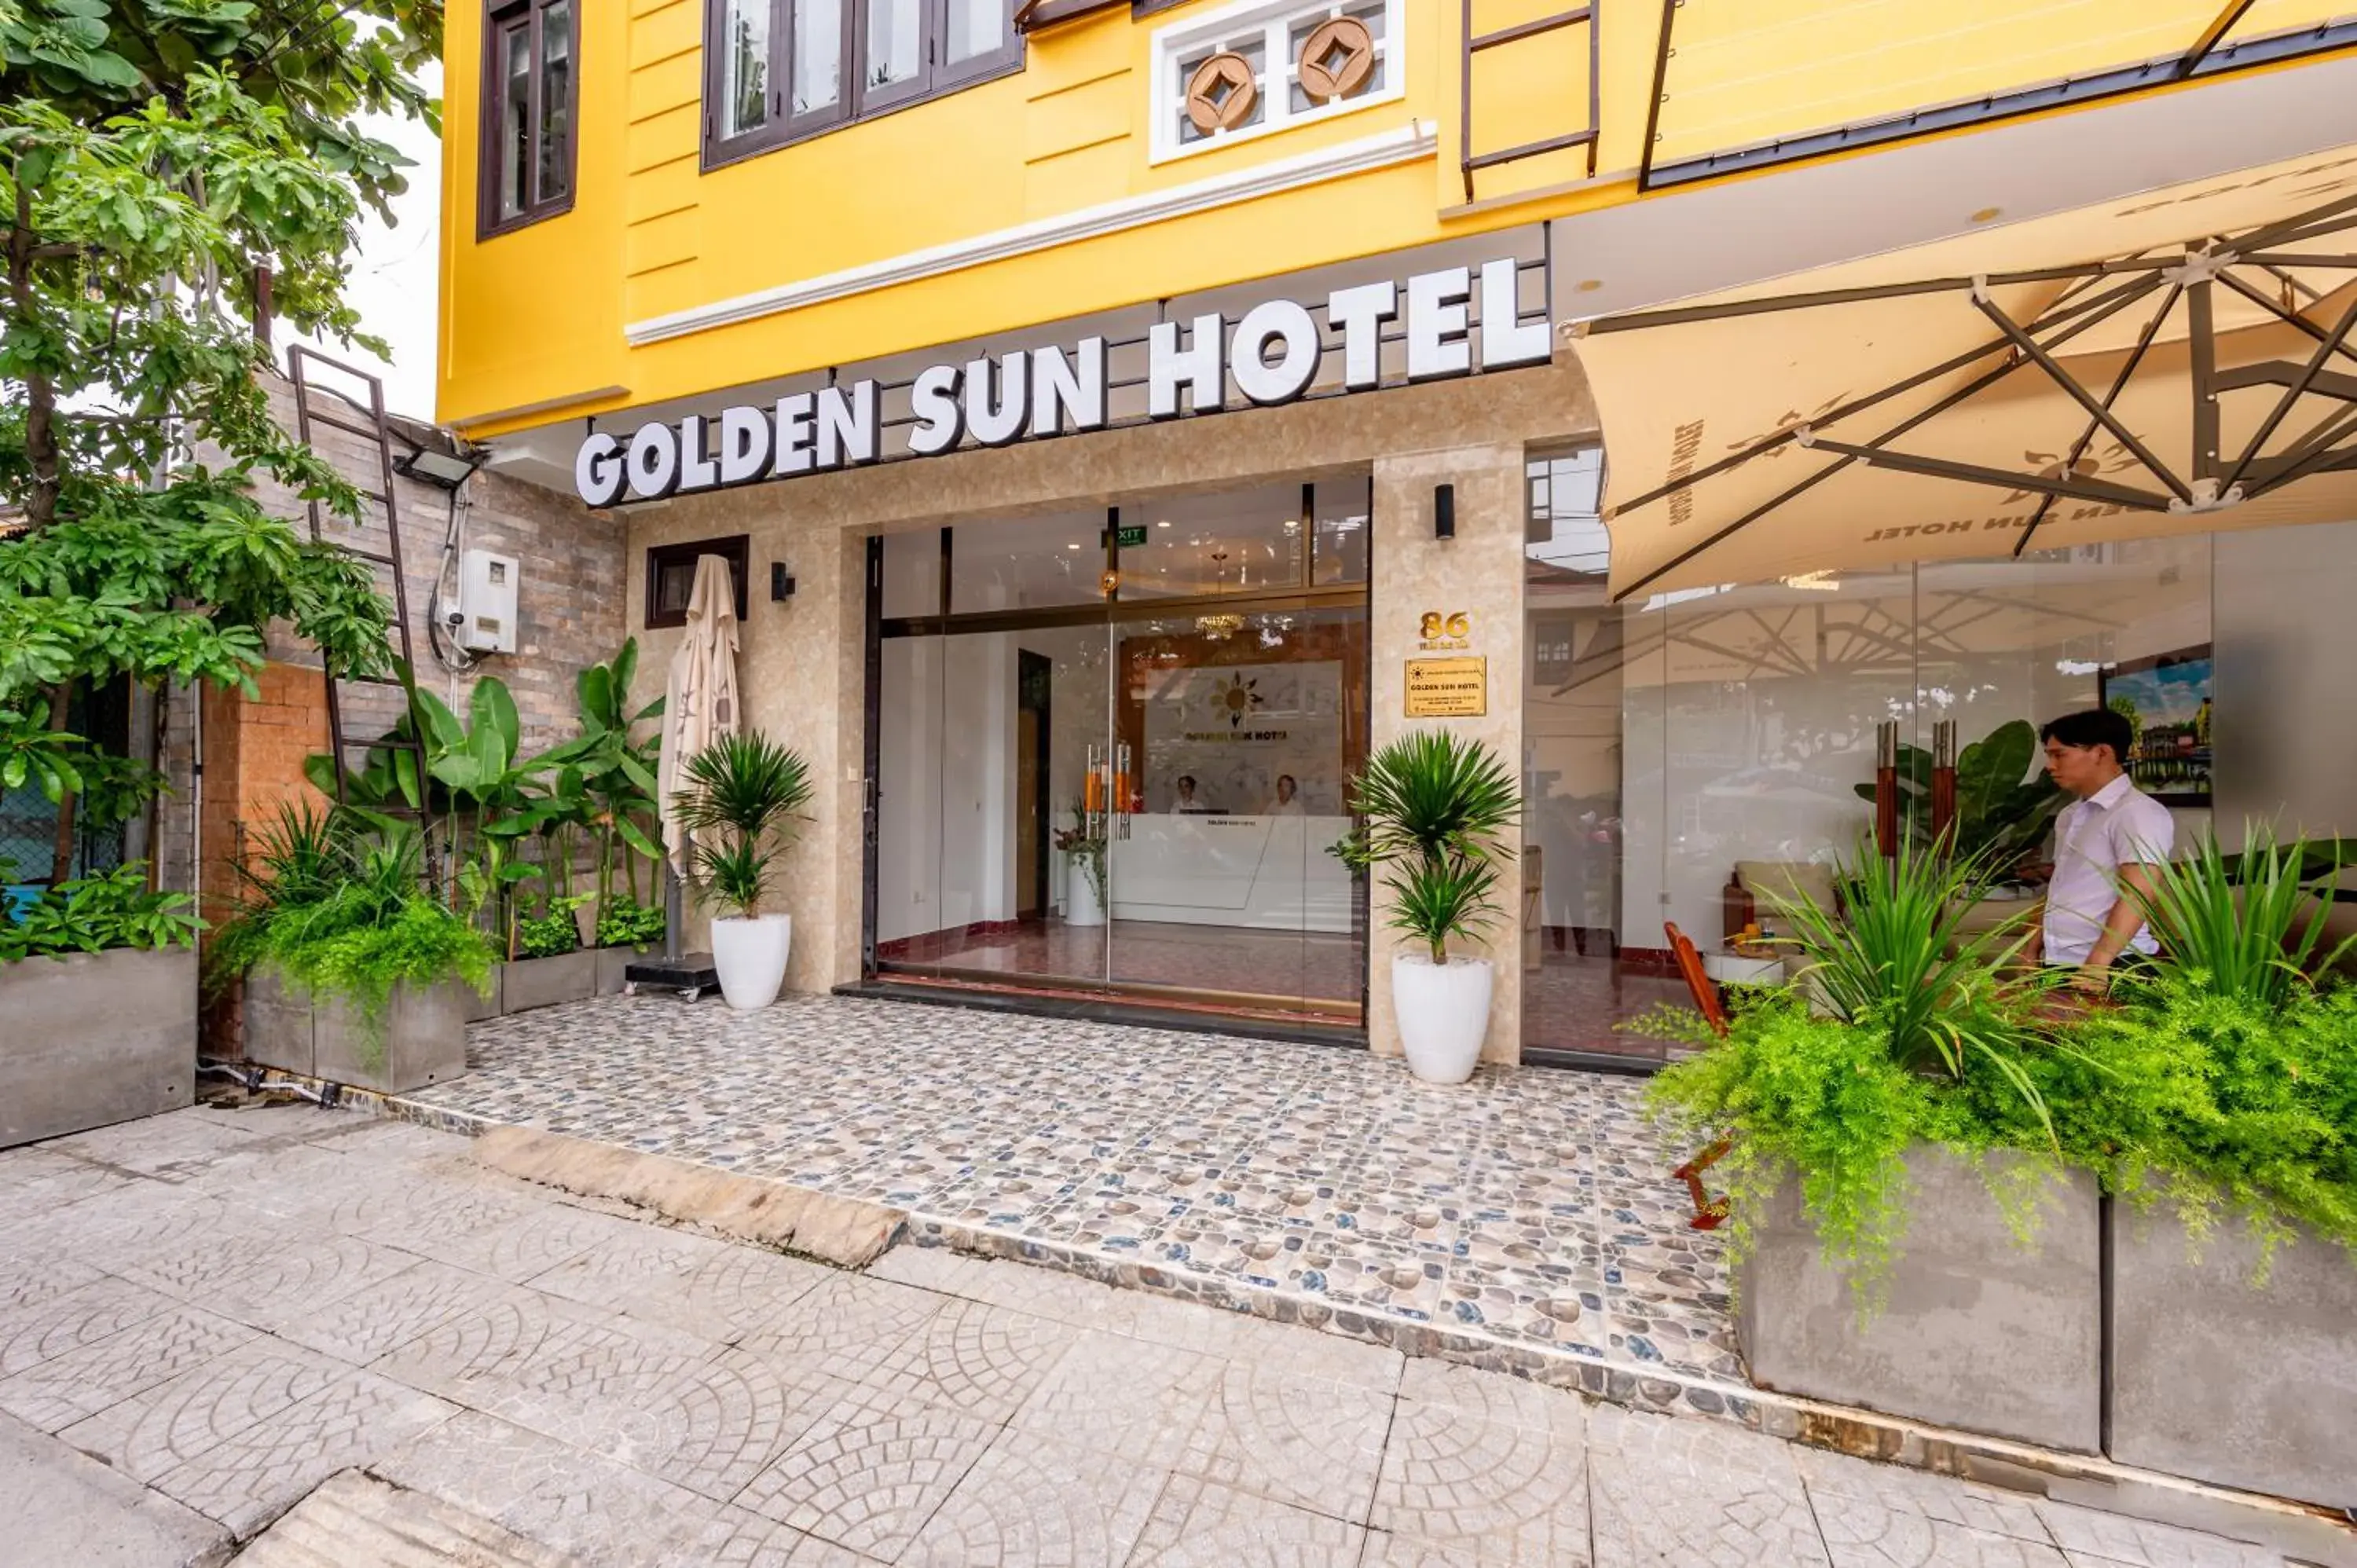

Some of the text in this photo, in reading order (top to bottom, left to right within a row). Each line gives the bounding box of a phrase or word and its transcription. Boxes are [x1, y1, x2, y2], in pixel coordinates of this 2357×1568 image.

[575, 257, 1552, 507] GOLDEN SUN HOTEL
[1420, 611, 1468, 639] 86
